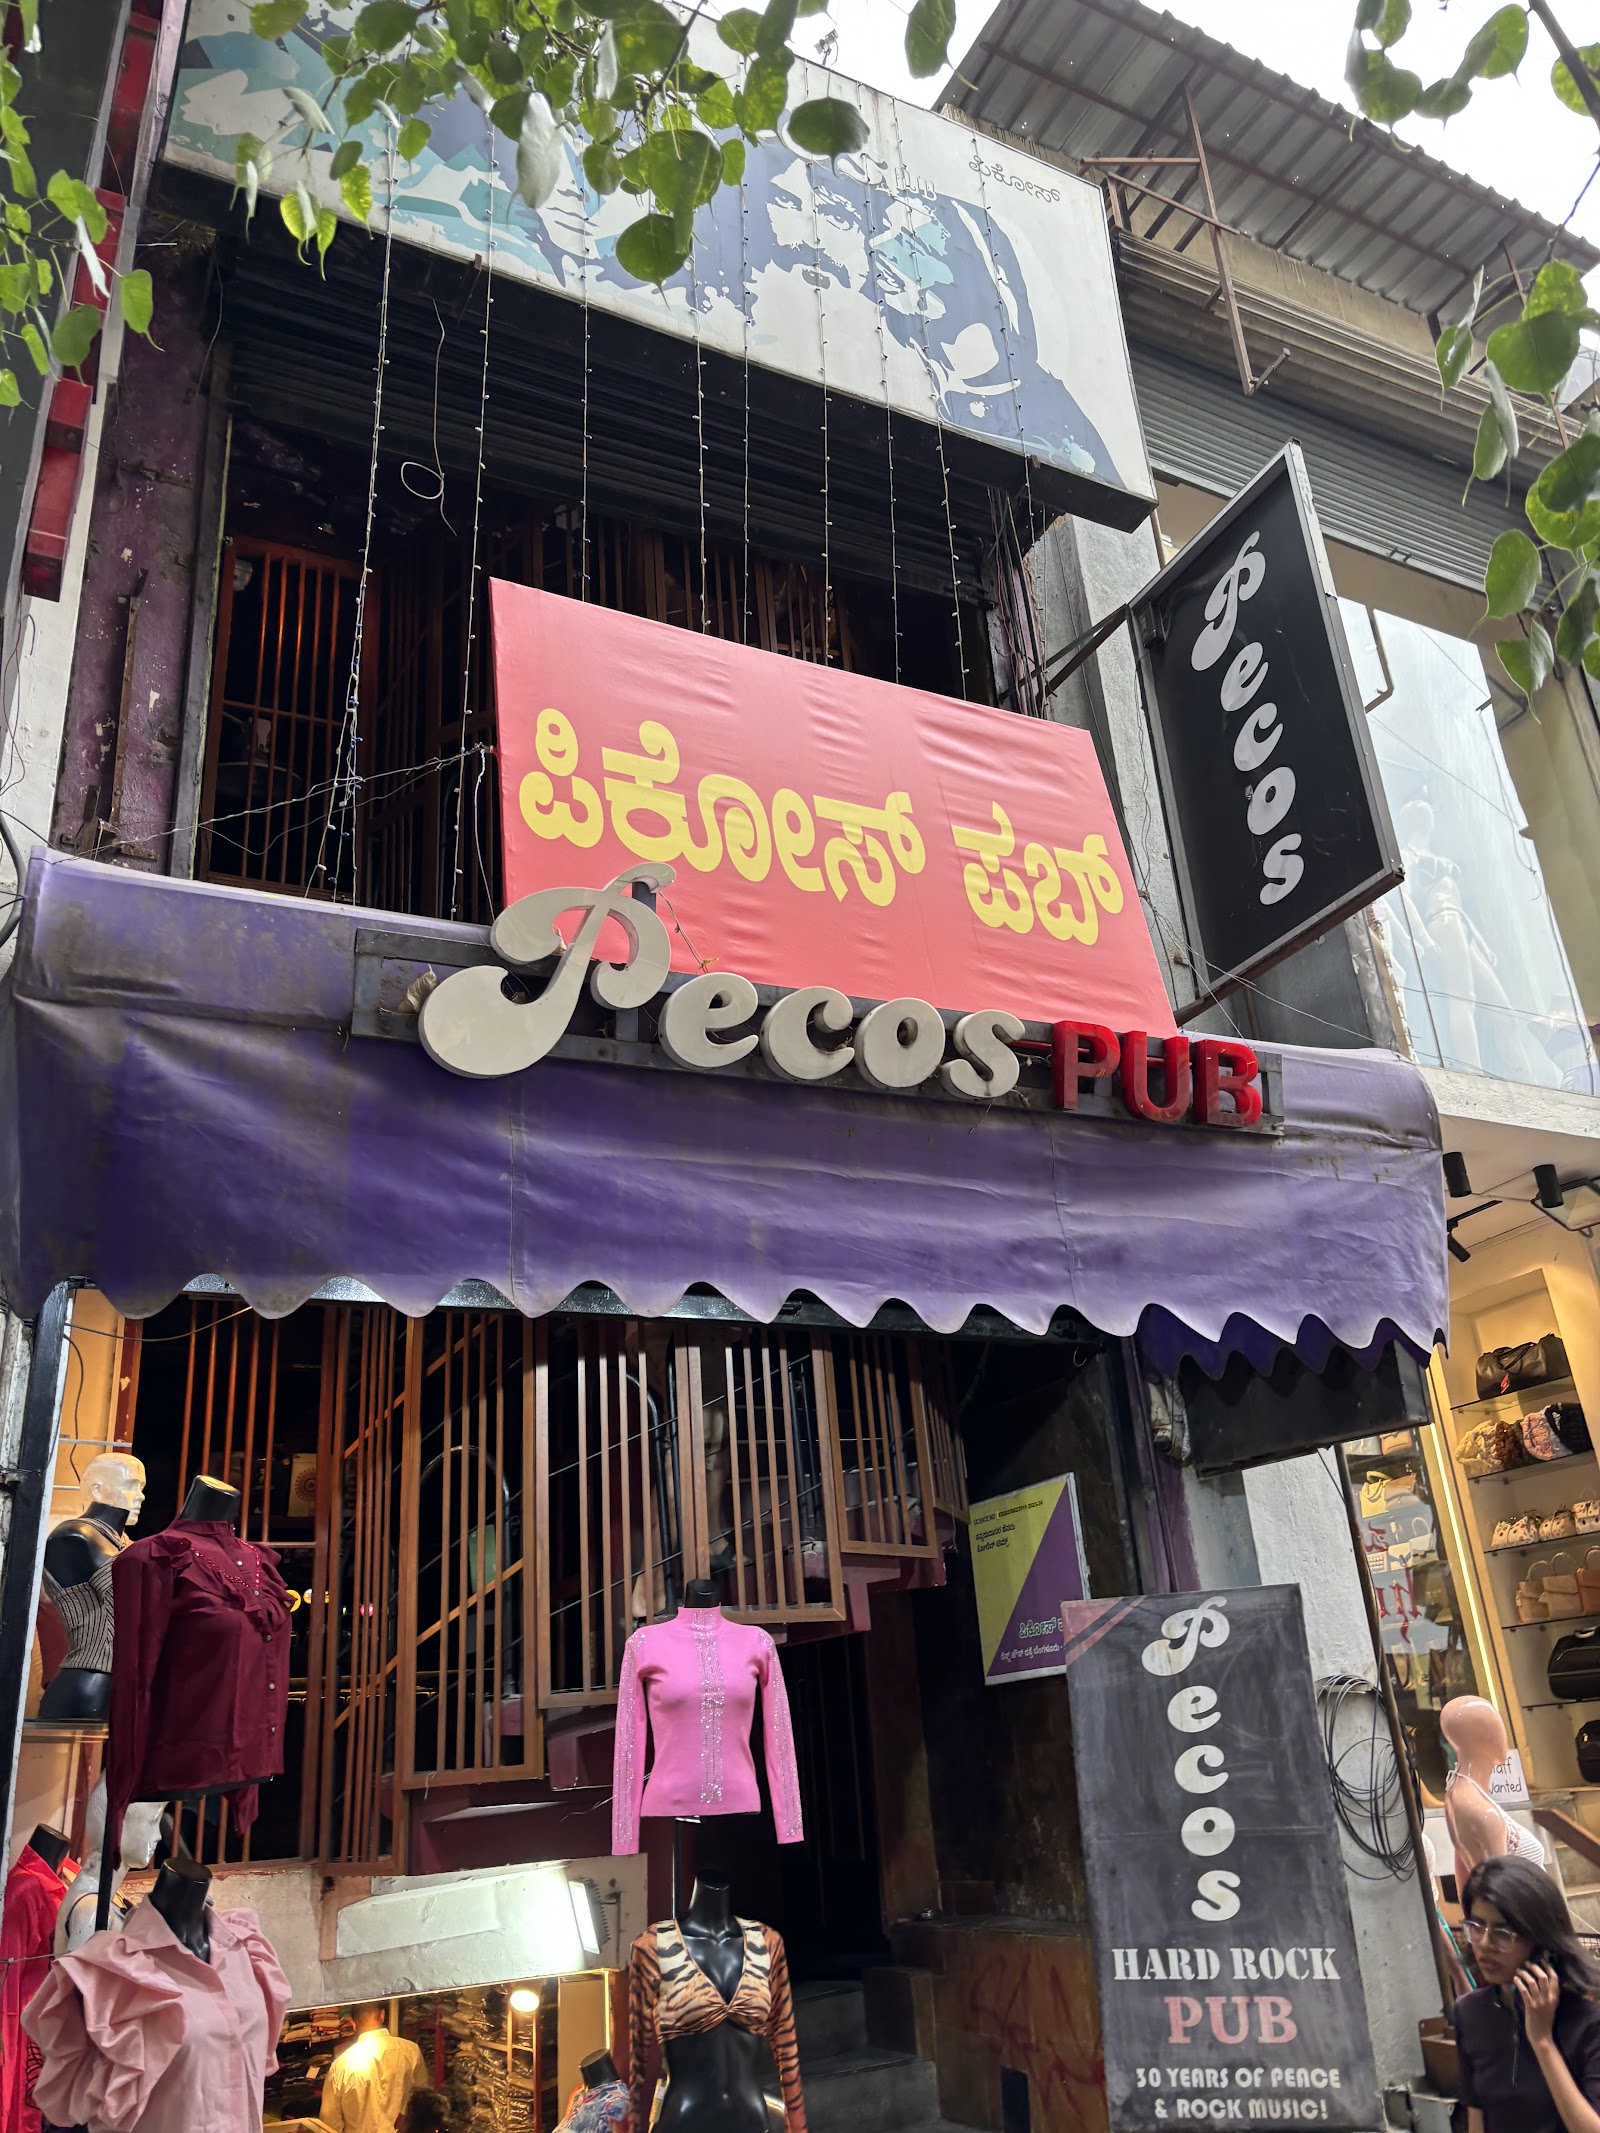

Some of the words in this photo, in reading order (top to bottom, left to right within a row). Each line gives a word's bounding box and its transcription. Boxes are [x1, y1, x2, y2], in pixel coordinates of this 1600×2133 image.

[1191, 530, 1305, 906] Pecos
[519, 708, 926, 906] ಪಿಕೋಸ್
[419, 863, 1026, 1100] Pecos
[1052, 1021, 1264, 1130] PUB
[1142, 1596, 1241, 1921] Pecos
[1112, 1948, 1220, 1980] HARD
[1230, 1947, 1340, 1979] ROCK
[1164, 1996, 1297, 2044] PUB
[1136, 2068, 1161, 2088] 30
[1166, 2068, 1229, 2088] YEARS
[1235, 2068, 1264, 2088] OF
[1271, 2068, 1341, 2089] PEACE
[1155, 2100, 1168, 2119] &
[1177, 2099, 1243, 2119] ROCK
[1248, 2099, 1328, 2120] MUSIC!
